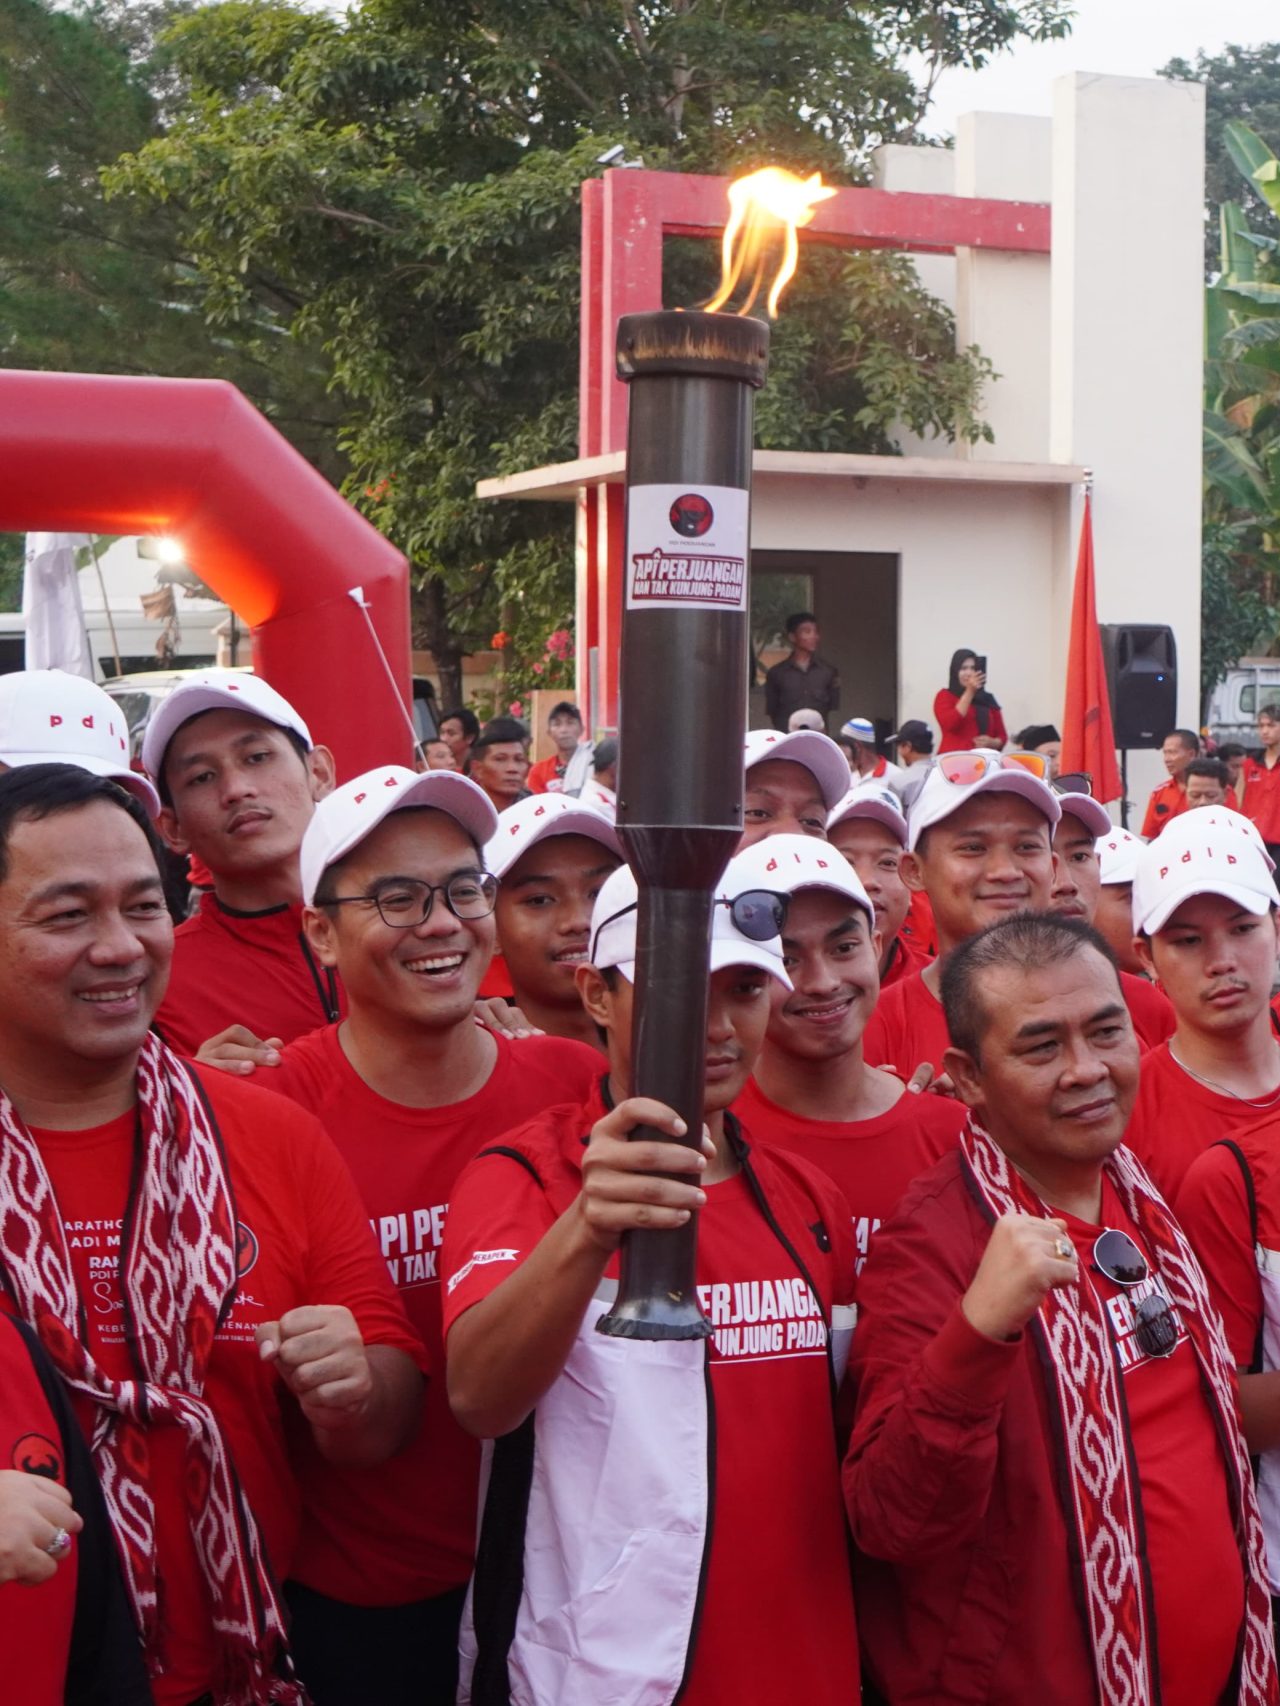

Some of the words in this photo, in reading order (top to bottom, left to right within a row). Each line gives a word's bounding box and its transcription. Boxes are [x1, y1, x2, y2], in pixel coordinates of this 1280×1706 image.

[659, 557, 744, 585] PERJUANGAN
[634, 580, 650, 596] NAN
[651, 580, 669, 596] TAK
[670, 581, 714, 597] KUNJUNG
[714, 584, 742, 600] PADAM
[107, 1235, 121, 1247] M
[412, 1203, 449, 1251] PE
[403, 1250, 437, 1283] TAK
[696, 1278, 824, 1326] ERJUANGA
[97, 1323, 126, 1333] KEBE
[222, 1321, 258, 1331] ENAN
[711, 1322, 784, 1357] UNJUNG
[786, 1320, 827, 1350] PADA
